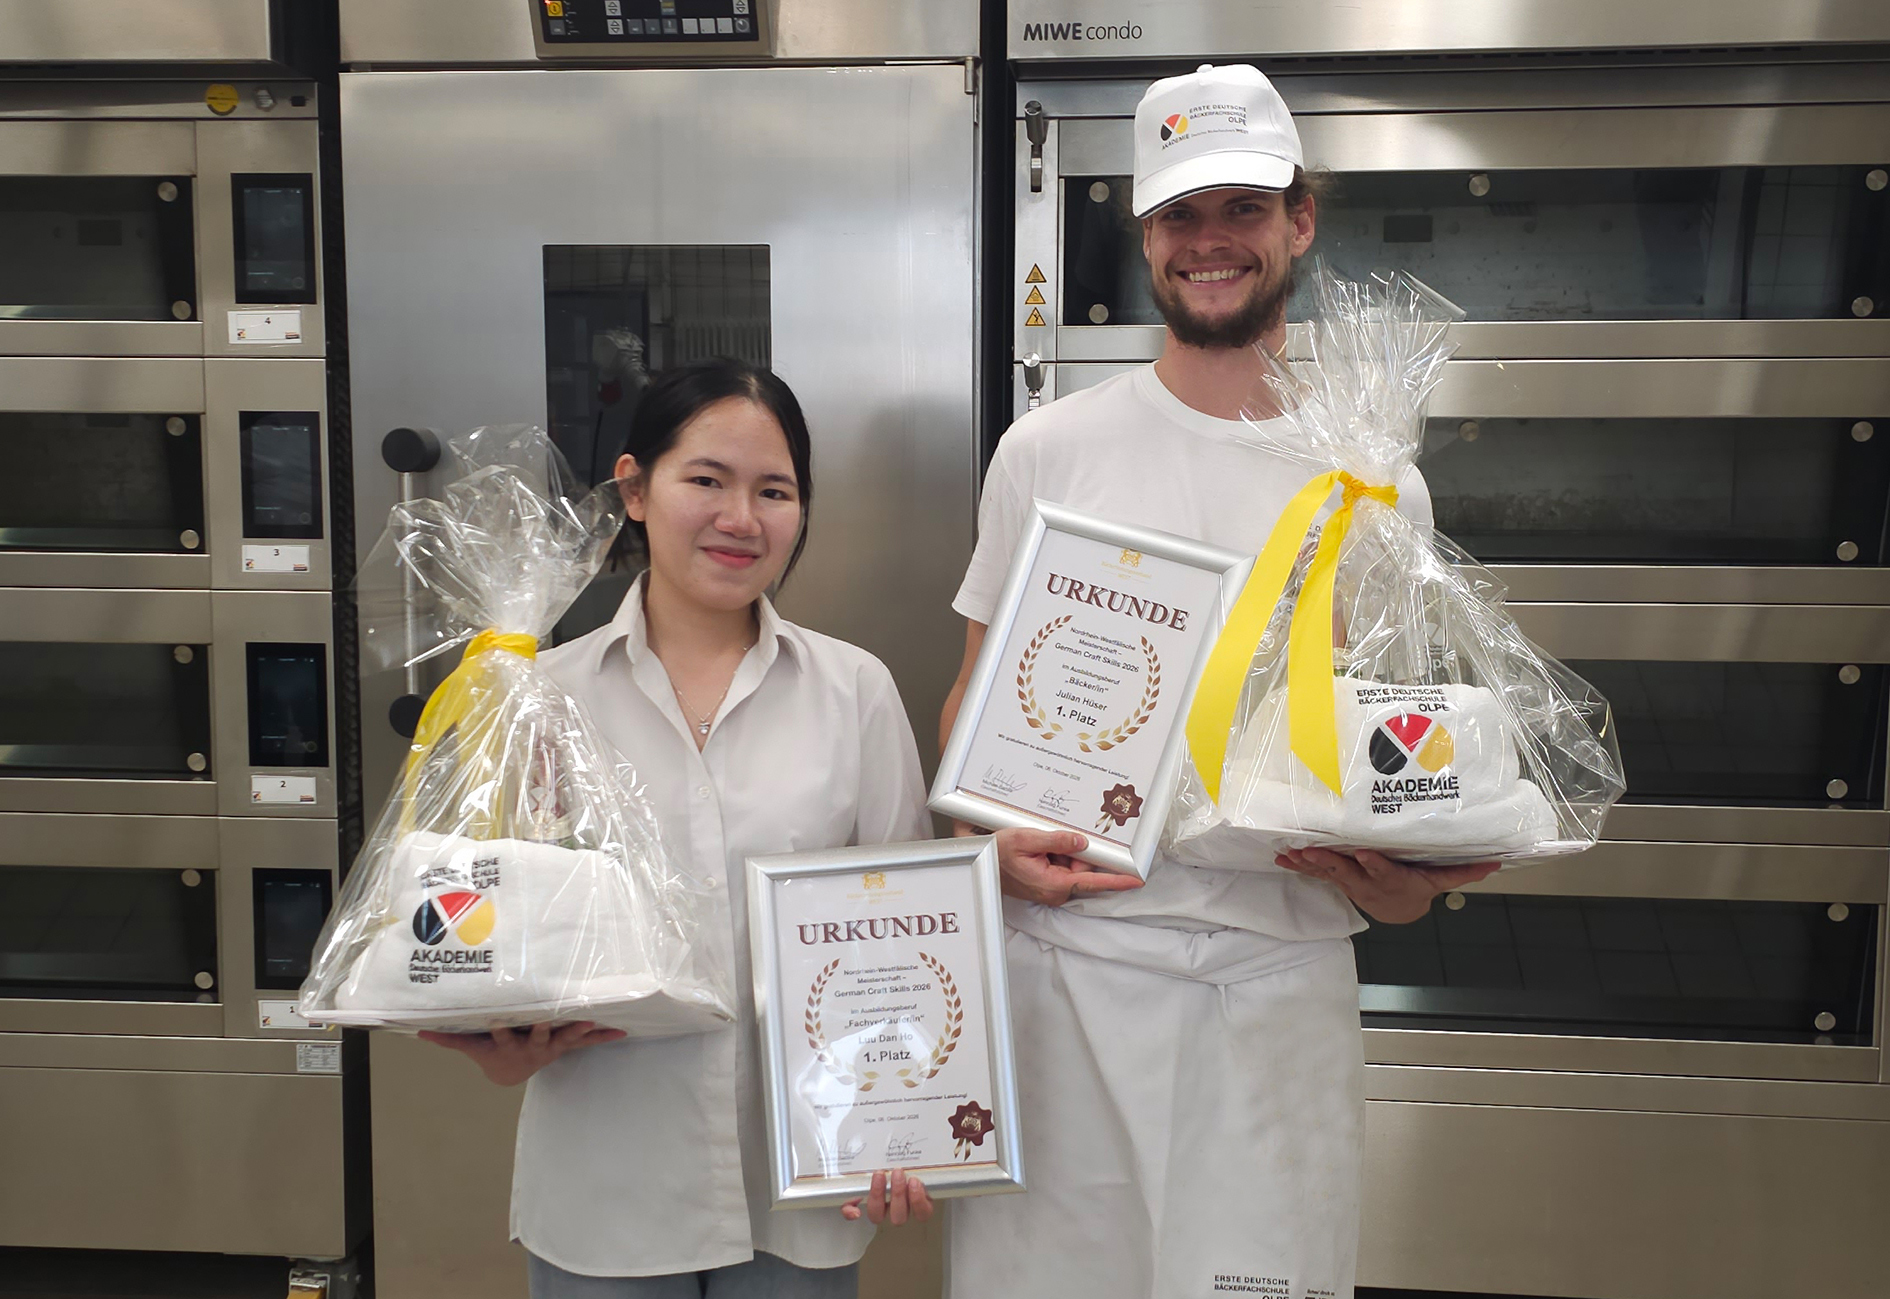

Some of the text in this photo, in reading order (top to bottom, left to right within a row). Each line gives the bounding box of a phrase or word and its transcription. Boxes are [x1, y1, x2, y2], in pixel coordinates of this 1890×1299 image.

[1023, 20, 1142, 40] MIWE condo
[1189, 104, 1246, 114] ERSTE DEUTSCHE
[1228, 116, 1247, 126] OLPE
[1046, 572, 1190, 632] URKUNDE
[1079, 638, 1118, 655] Meisterschaft
[1055, 642, 1140, 672] German Craft Skills 2026
[1356, 688, 1390, 697] ERSTE
[1056, 690, 1108, 711] Julian Hüser
[1358, 695, 1448, 705] BÄCKERFACHSCHULE
[1418, 703, 1450, 712] OLPE
[1056, 706, 1097, 726] 1. Platz
[1371, 776, 1460, 793] AKADEMIE
[1371, 804, 1402, 814] WEST
[797, 912, 960, 945] URKUNDE
[410, 949, 493, 963] AKADEMIE
[410, 974, 439, 983] WEST
[857, 975, 902, 984] Meisterschaft
[834, 989, 866, 998] German
[868, 987, 887, 995] Craft
[912, 984, 931, 992] 2026
[879, 1034, 897, 1042] Dan
[864, 1050, 911, 1062] 1. Platz
[1214, 1274, 1290, 1286] ERSTE DEUTSCHE
[1214, 1284, 1290, 1295] BÄCKERFACHSCHULE
